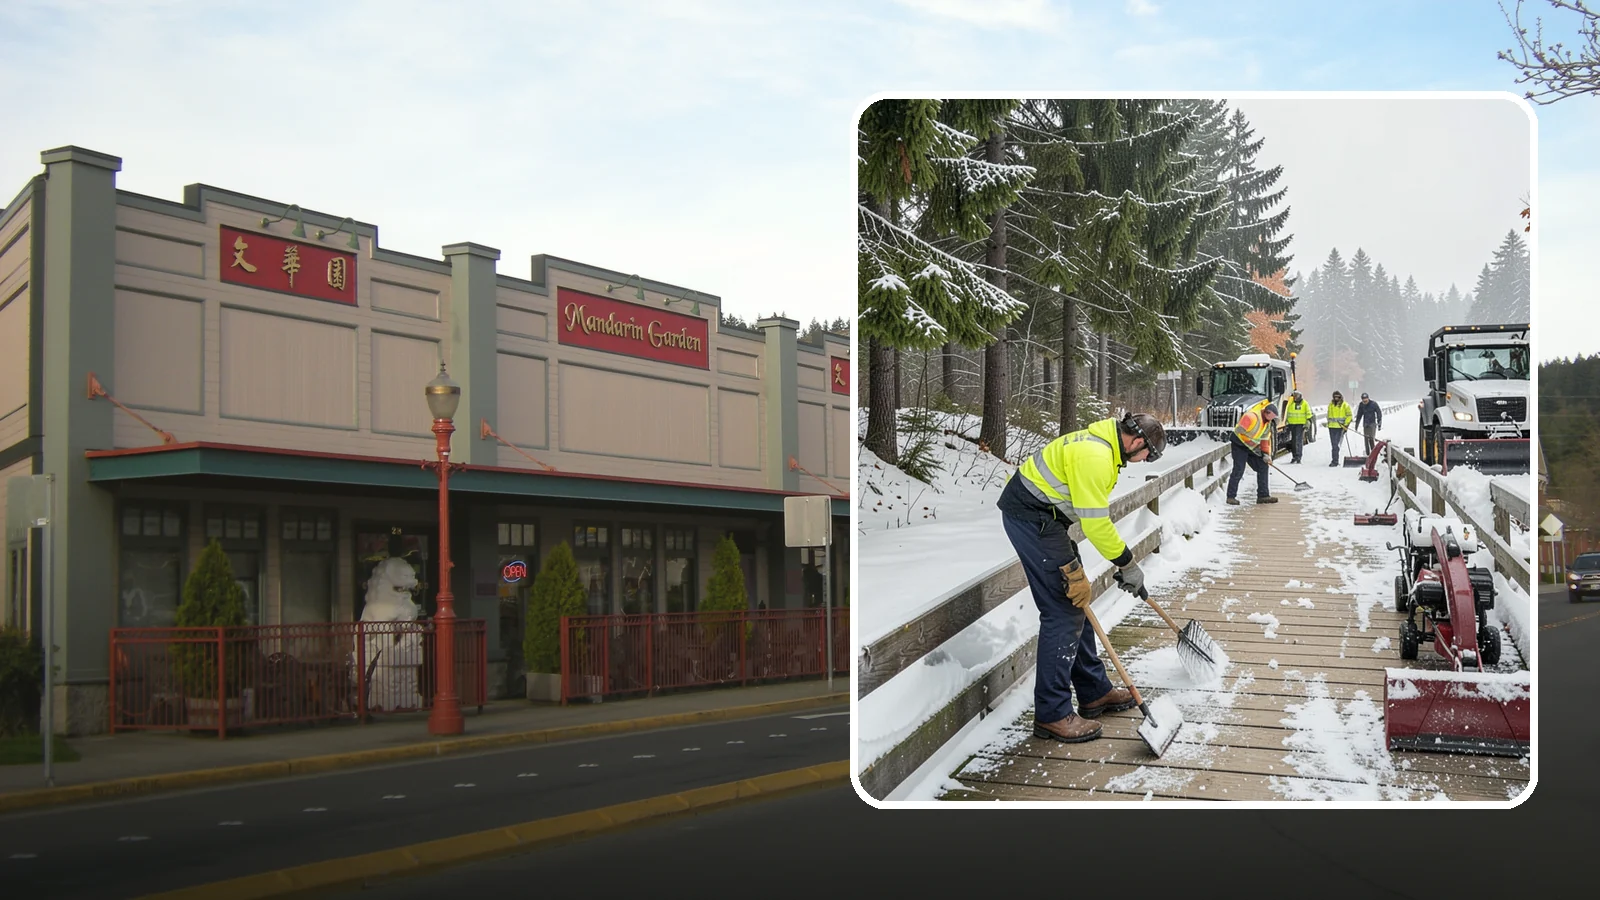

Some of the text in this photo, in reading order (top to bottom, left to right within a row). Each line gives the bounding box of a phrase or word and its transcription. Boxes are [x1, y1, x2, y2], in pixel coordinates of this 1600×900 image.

[564, 301, 702, 352] Mandarin Garden
[503, 564, 527, 579] OPEN
